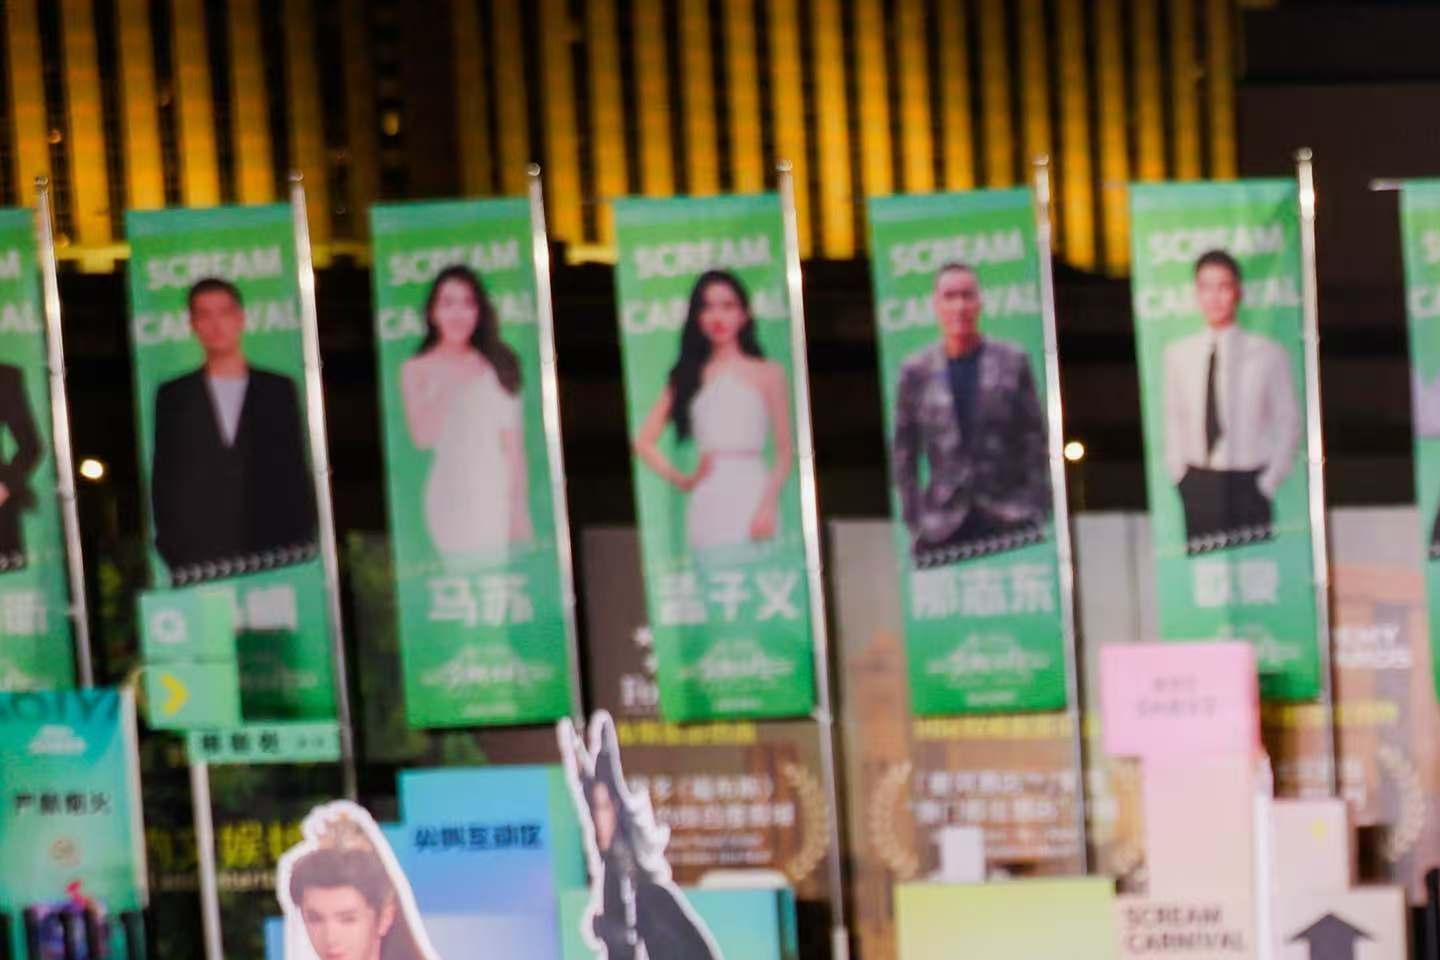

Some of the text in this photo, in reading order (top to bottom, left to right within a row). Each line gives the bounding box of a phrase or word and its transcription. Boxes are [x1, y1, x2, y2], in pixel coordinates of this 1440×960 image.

[635, 235, 770, 279] SCREAM
[889, 228, 1025, 276] SCREAM
[1148, 224, 1284, 264] SCREAM
[146, 246, 283, 290] SCREAM
[1126, 906, 1224, 930] SCREAM
[1127, 932, 1247, 954] CARNIVAL
